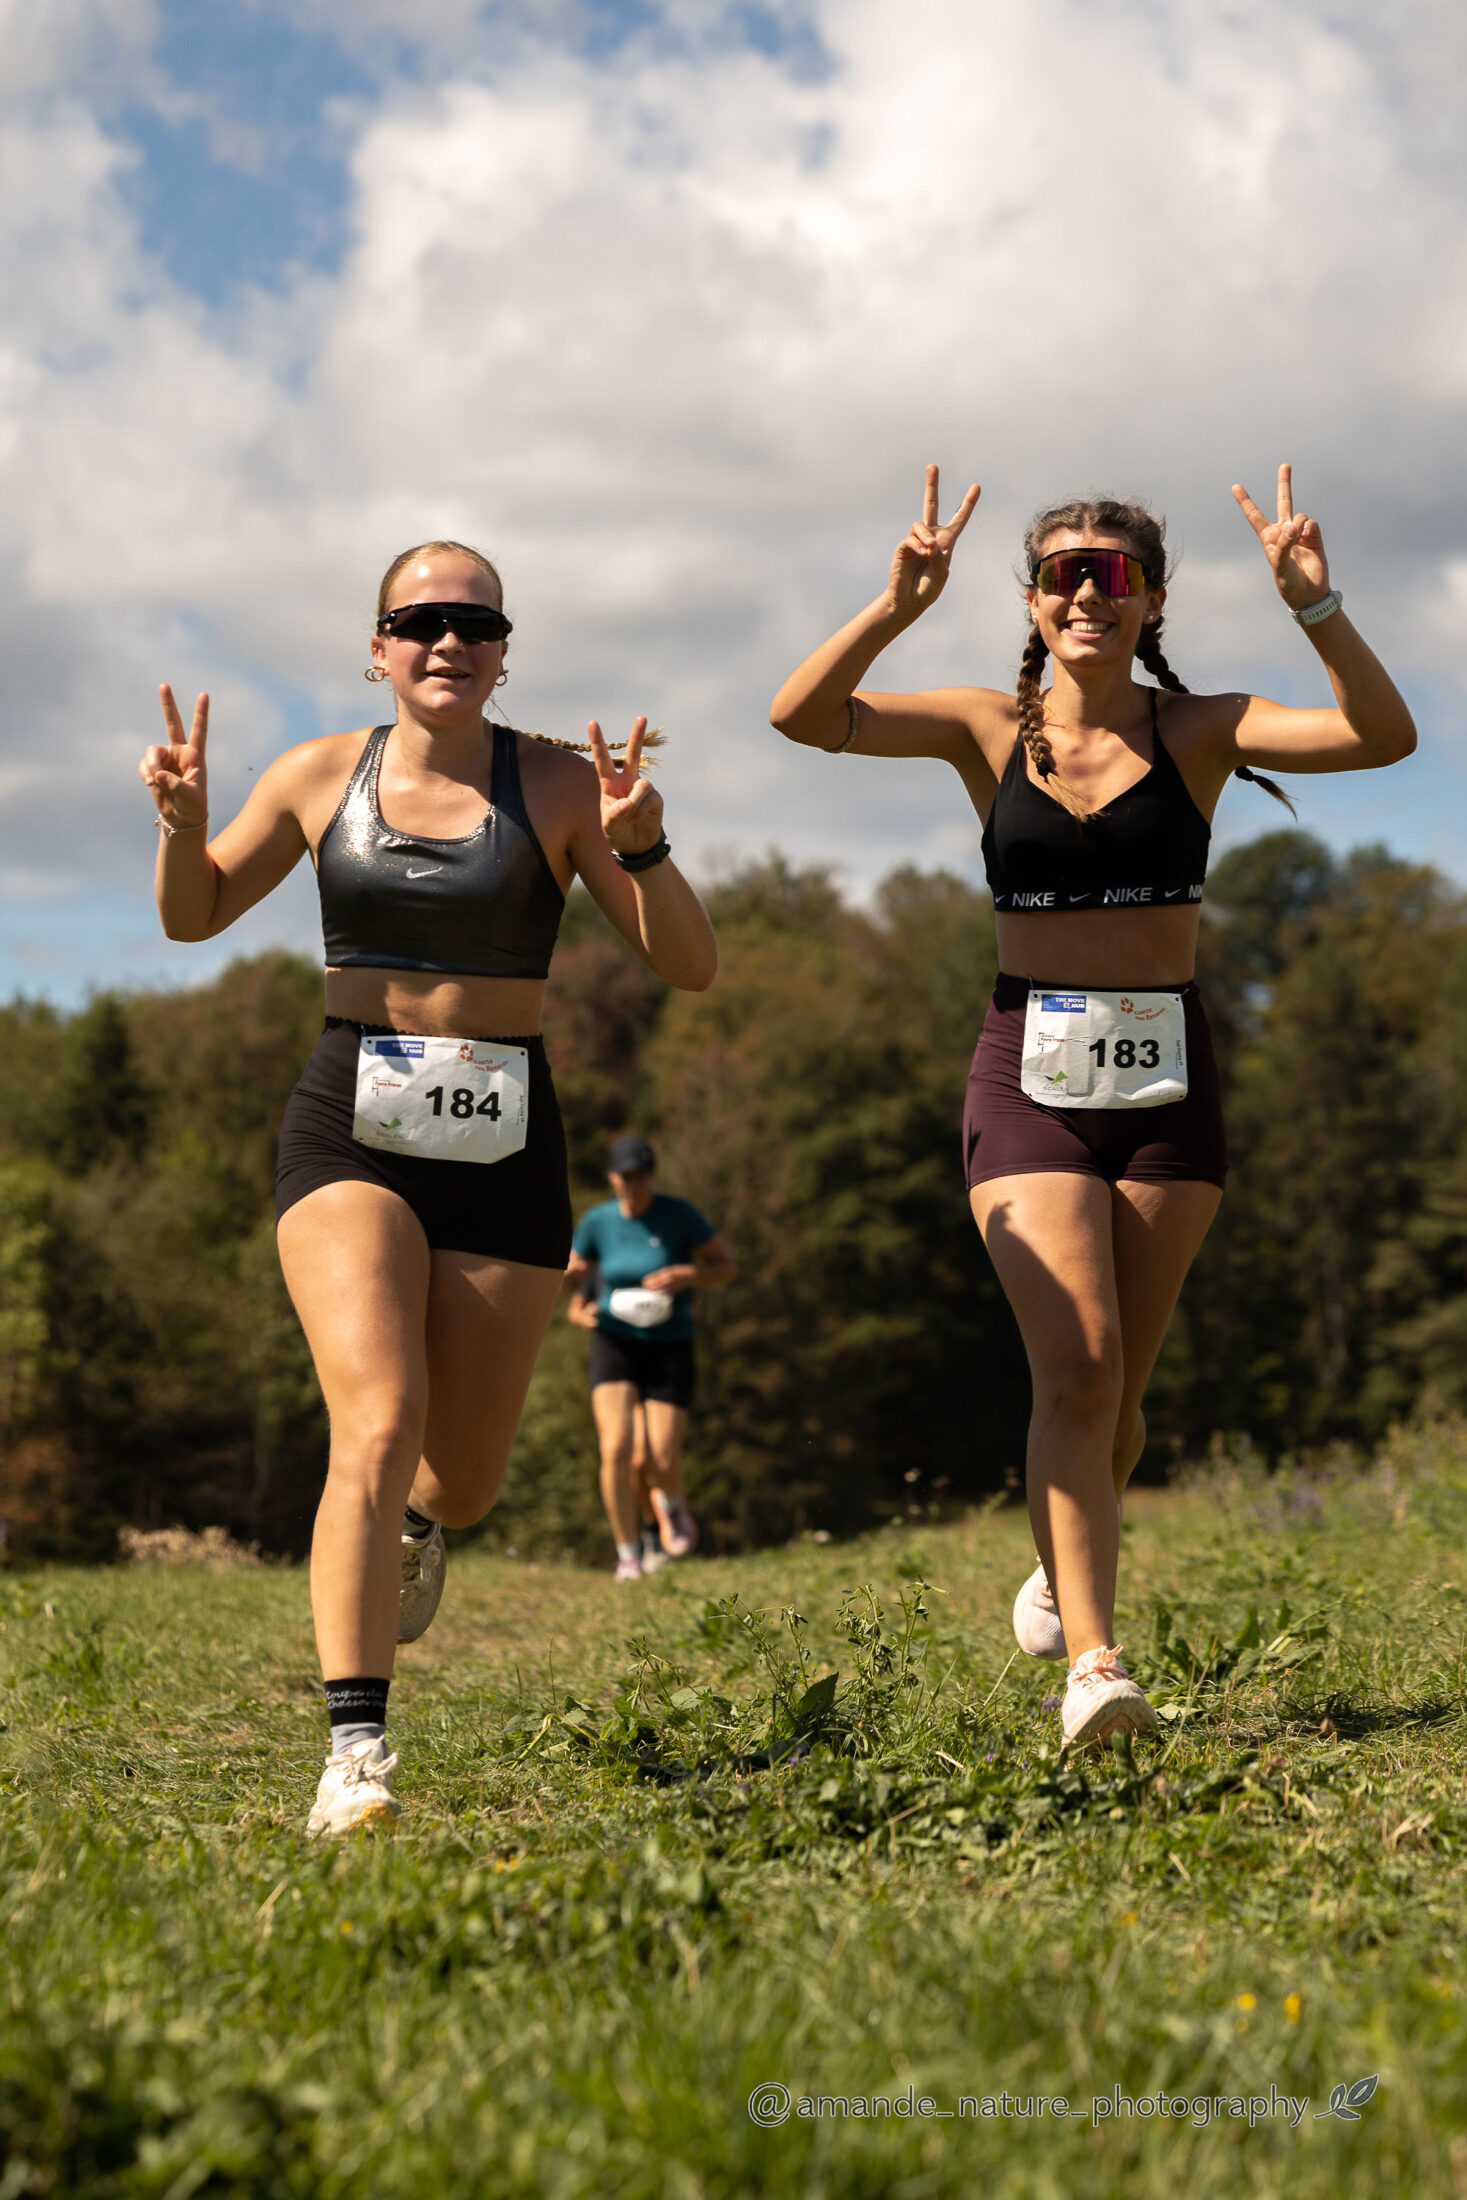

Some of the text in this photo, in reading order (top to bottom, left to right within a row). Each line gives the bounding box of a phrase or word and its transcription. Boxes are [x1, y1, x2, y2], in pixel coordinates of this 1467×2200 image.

[1012, 891, 1056, 907] NIKE
[1104, 886, 1154, 904] NIKE
[1089, 1038, 1160, 1069] 183
[425, 1086, 502, 1122] 184
